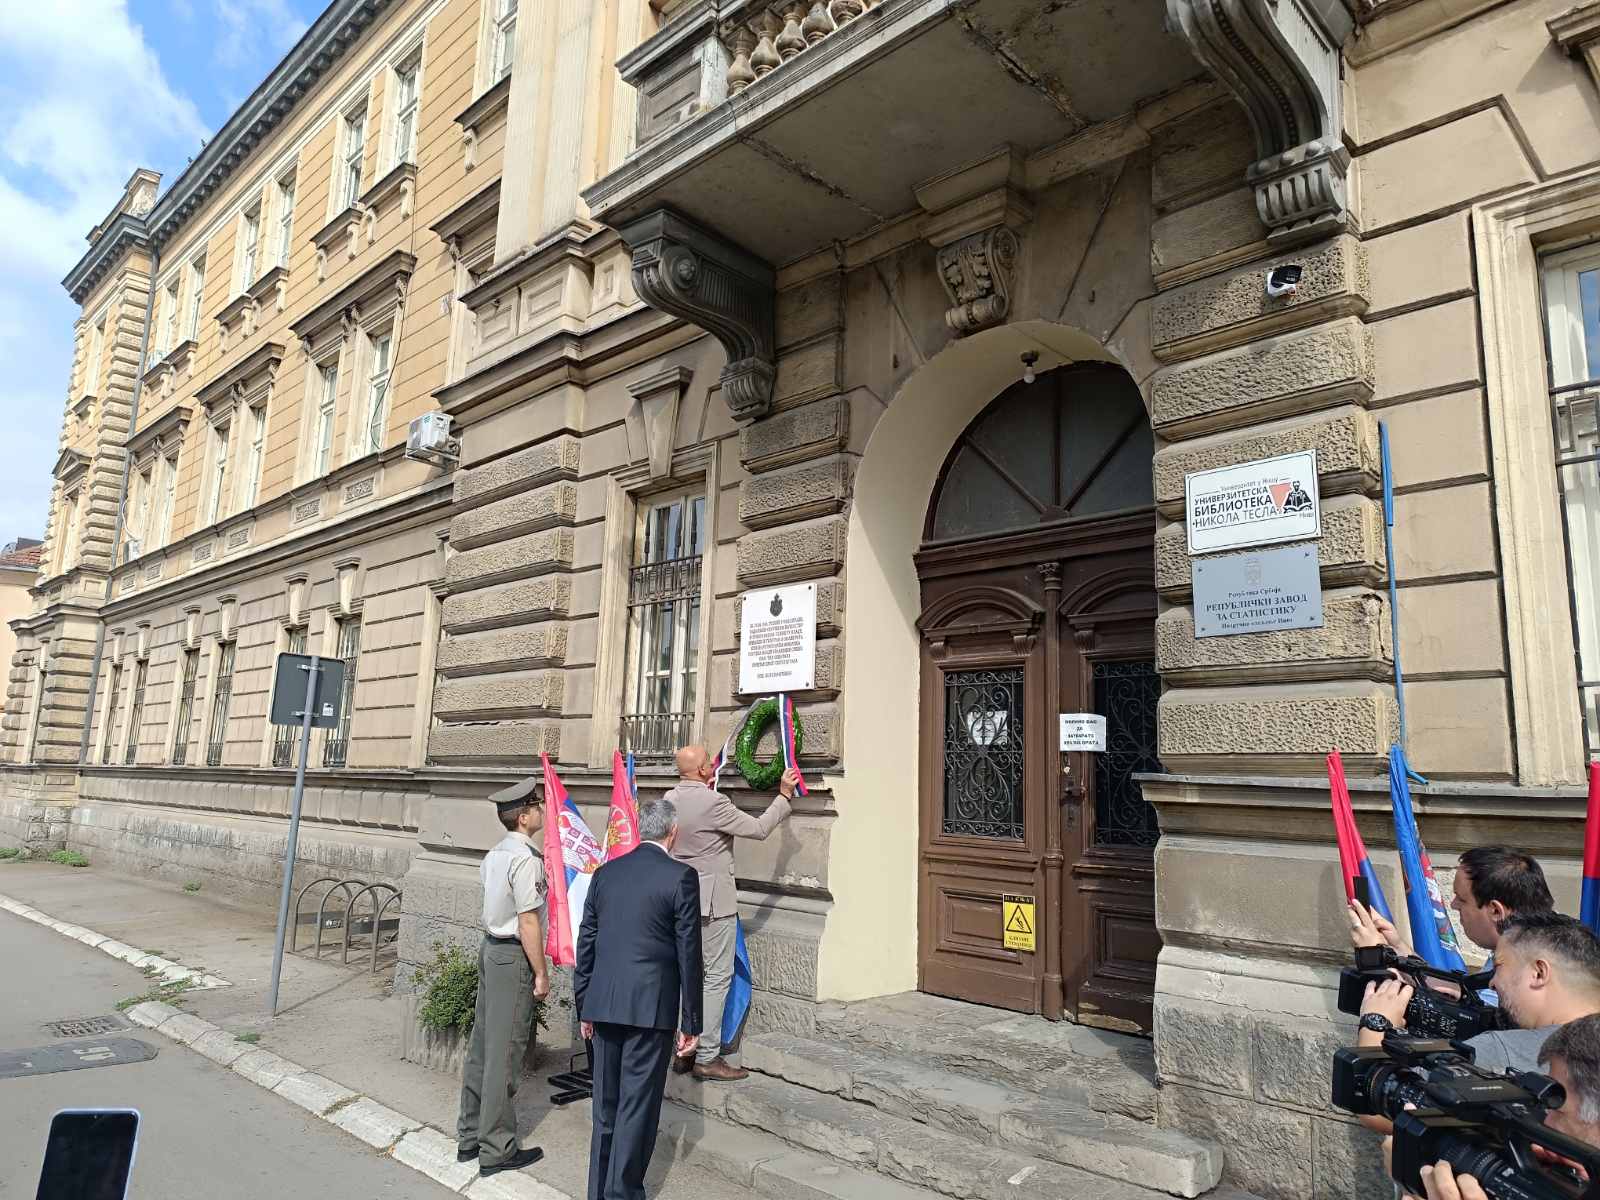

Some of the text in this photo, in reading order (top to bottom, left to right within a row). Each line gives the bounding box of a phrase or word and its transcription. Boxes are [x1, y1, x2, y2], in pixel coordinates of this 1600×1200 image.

[1194, 486, 1268, 506] УНИВЕРЗИТЕТСКА
[1195, 495, 1273, 517] БИБЛИОТЕКА
[1206, 593, 1308, 612] РЕПУБЛИЧКИ ЗАВОД
[1216, 605, 1297, 621] ЗА СТАТИСТИКУ
